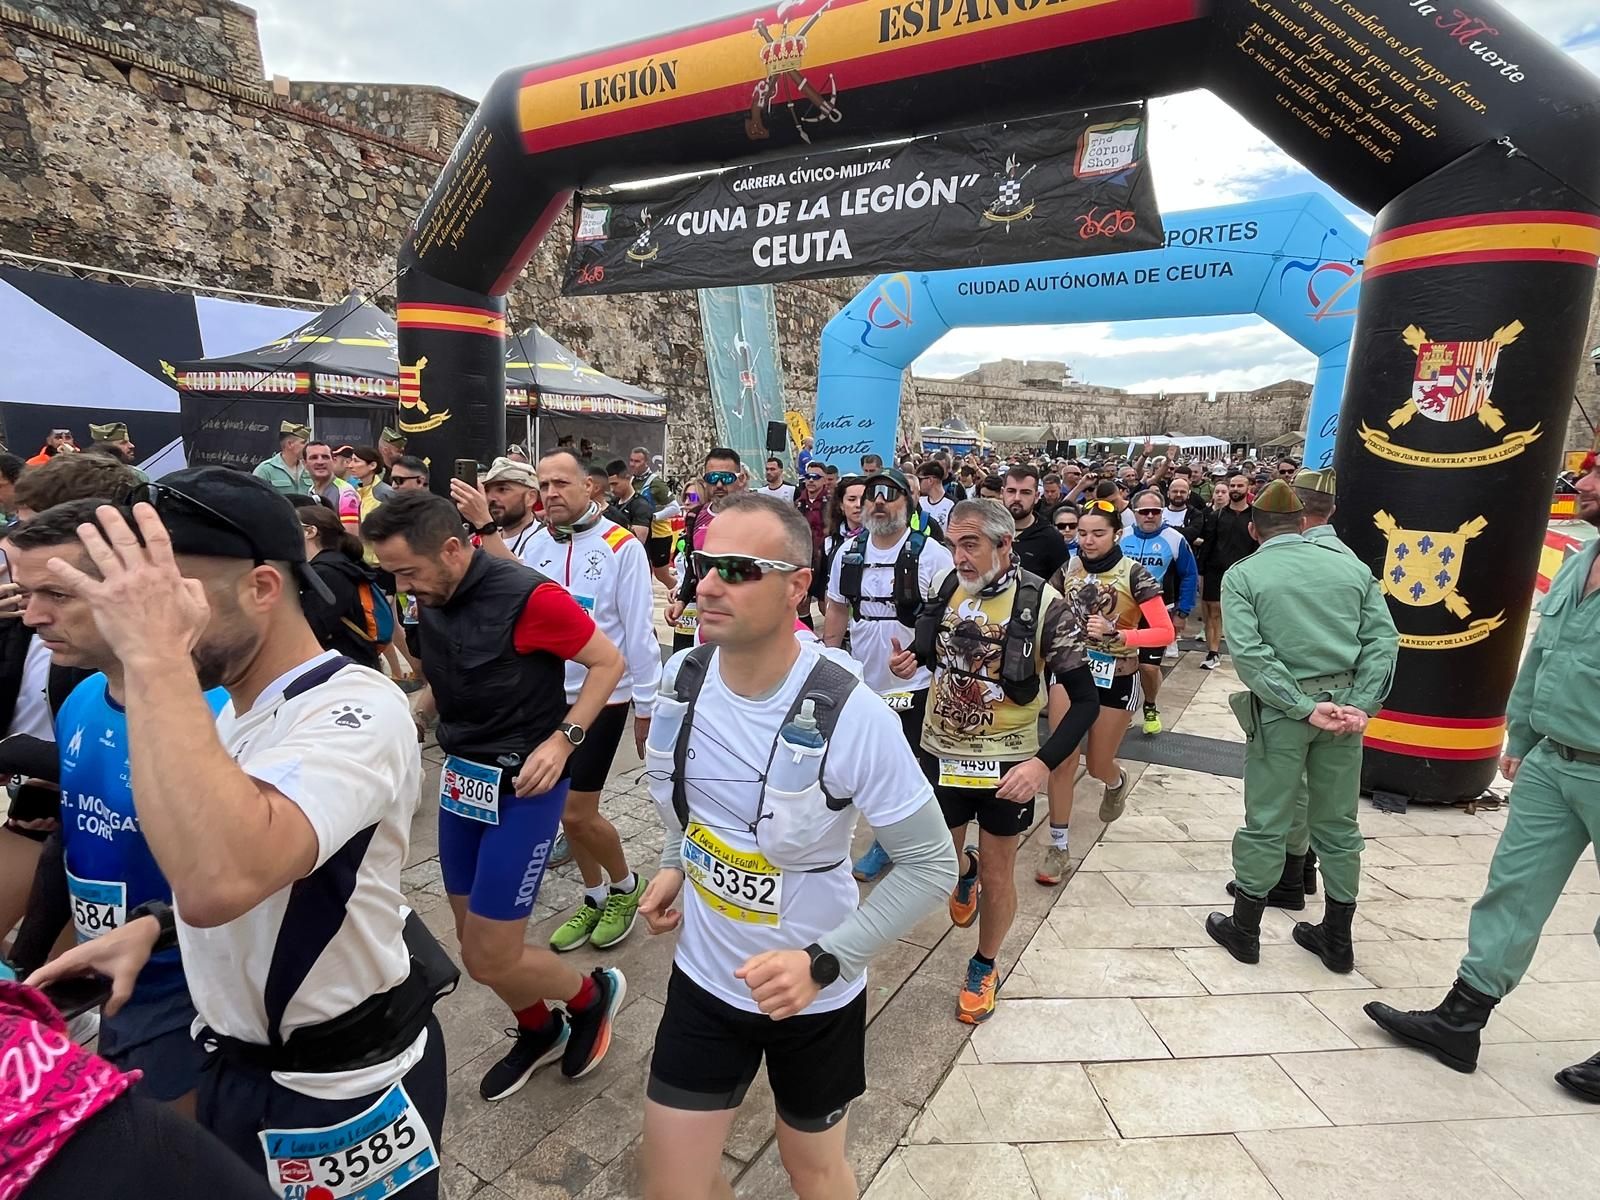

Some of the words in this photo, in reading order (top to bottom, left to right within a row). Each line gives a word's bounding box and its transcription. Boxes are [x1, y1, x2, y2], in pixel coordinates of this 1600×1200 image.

[1269, 9, 1308, 40] muerte
[1341, 3, 1389, 39] combate
[1299, 2, 1313, 13] se
[1310, 11, 1347, 39] muere
[1344, 37, 1370, 56] más
[1361, 55, 1391, 73] que
[1389, 70, 1415, 91] una
[1413, 88, 1438, 110] vez.
[1305, 33, 1335, 61] llega
[1385, 36, 1402, 48] es
[1398, 46, 1423, 63] el
[1435, 9, 1526, 83] Muerte
[1332, 59, 1353, 75] sin
[1350, 65, 1382, 96] dolor
[1410, 56, 1451, 85] mayor
[579, 59, 680, 111] LEGIÓN
[1237, 31, 1256, 55] Lo
[1255, 54, 1276, 72] más
[1275, 67, 1319, 104] horrible
[1316, 102, 1329, 114] es
[1329, 112, 1357, 134] vivir
[1355, 134, 1394, 163] siendo
[1249, 23, 1264, 36] no
[1263, 33, 1277, 45] es
[1275, 41, 1296, 60] tan
[1293, 54, 1340, 93] horrible
[1336, 91, 1364, 114] como
[1355, 108, 1401, 145] parece.
[1448, 81, 1486, 115] honor.
[1276, 94, 1291, 108] un
[1370, 95, 1393, 109] y
[1390, 103, 1413, 119] el
[1401, 112, 1436, 138] morir
[733, 173, 786, 192] CARRERA
[789, 158, 892, 185] CÍVICO-MILITAR
[1087, 157, 1119, 168] Shop
[756, 201, 791, 228] DE
[797, 195, 831, 222] LA
[752, 228, 853, 268] CEUTA
[1163, 221, 1259, 247] PORTES
[958, 279, 1020, 296] CIUDAD
[1025, 271, 1129, 293] AUTÓNOMA
[1134, 268, 1160, 285] DE
[1166, 261, 1234, 281] CEUTA
[186, 371, 217, 391] CLUB
[219, 371, 296, 393] DEPORTIVO
[315, 373, 387, 397] TERCIO
[815, 438, 874, 462] Deporte
[1400, 453, 1419, 463] JUAN
[458, 776, 494, 803] 3806
[712, 861, 776, 906] 5352
[319, 1114, 416, 1188] 3585
